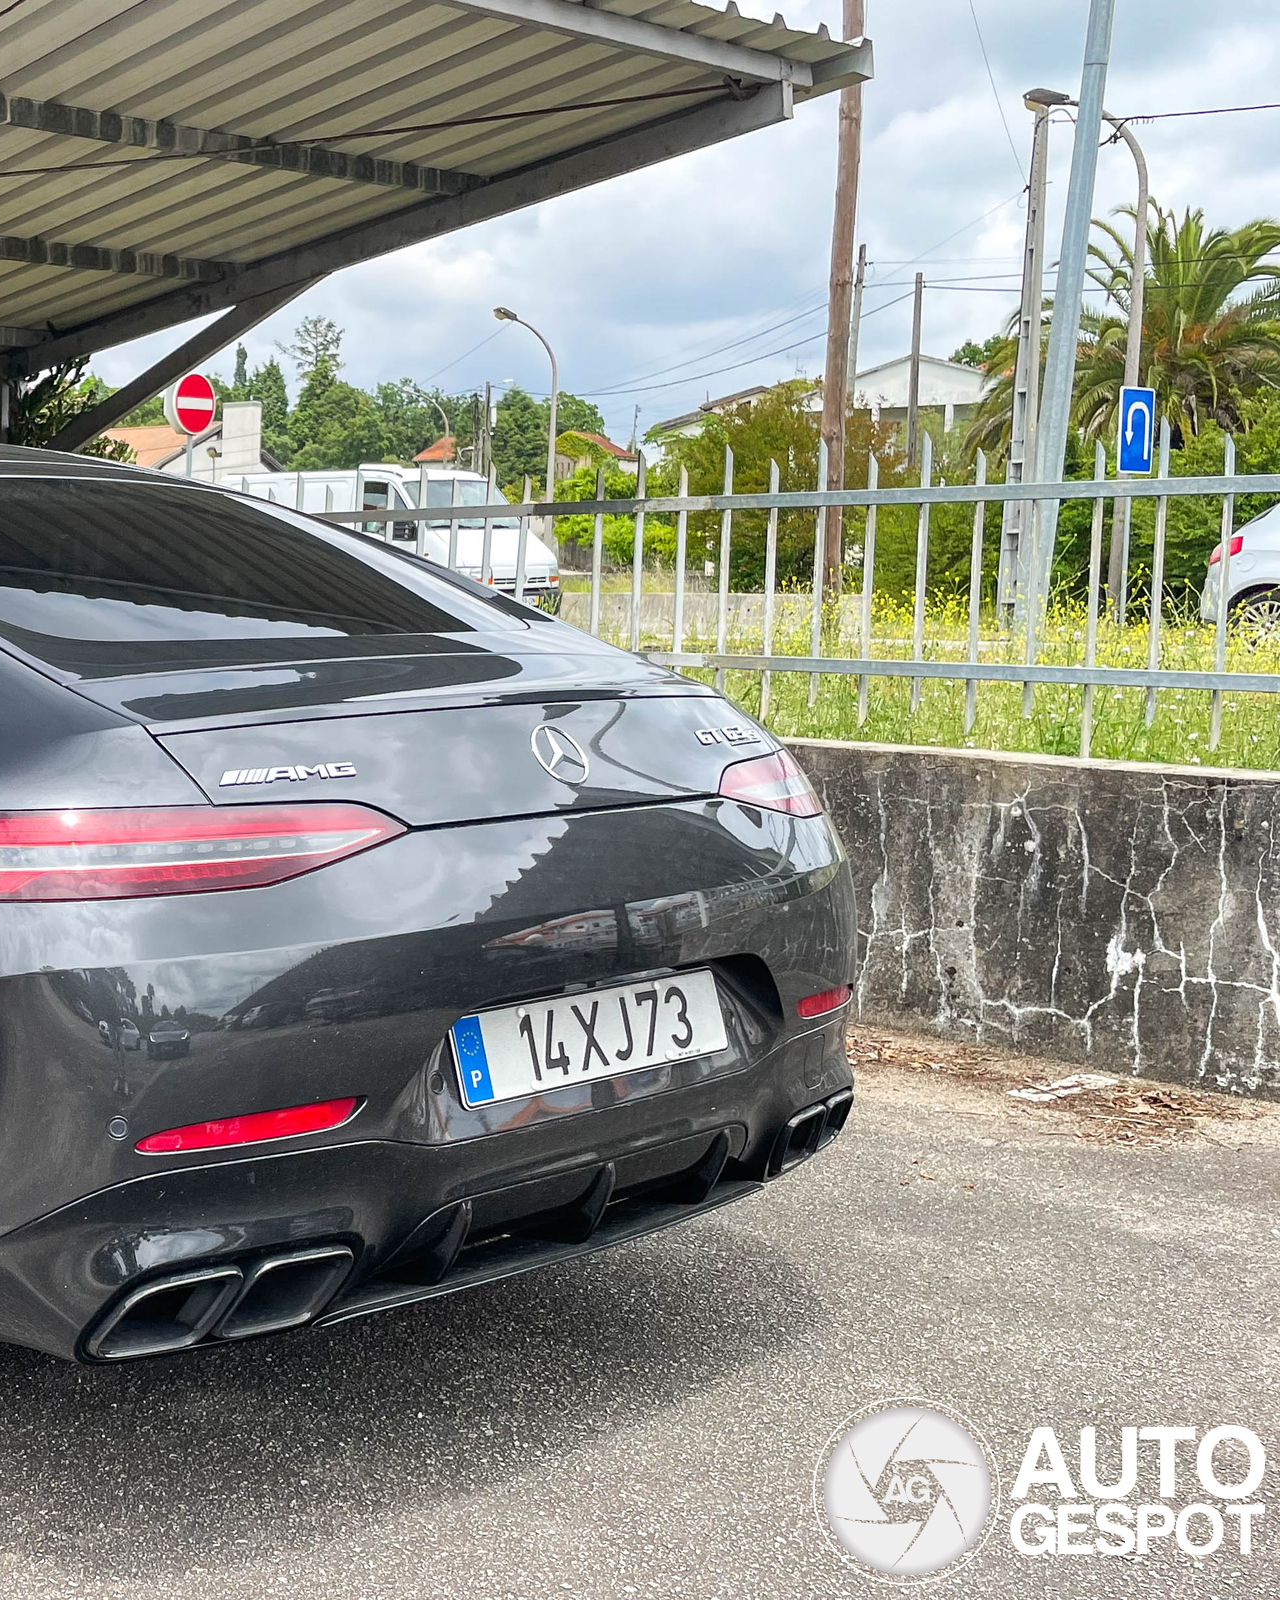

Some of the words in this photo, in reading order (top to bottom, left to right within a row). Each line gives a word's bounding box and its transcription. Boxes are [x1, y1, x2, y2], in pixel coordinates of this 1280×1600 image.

[694, 729, 723, 745] GT
[265, 761, 357, 785] AMG
[519, 986, 693, 1081] 14XJ73
[471, 1069, 482, 1088] P
